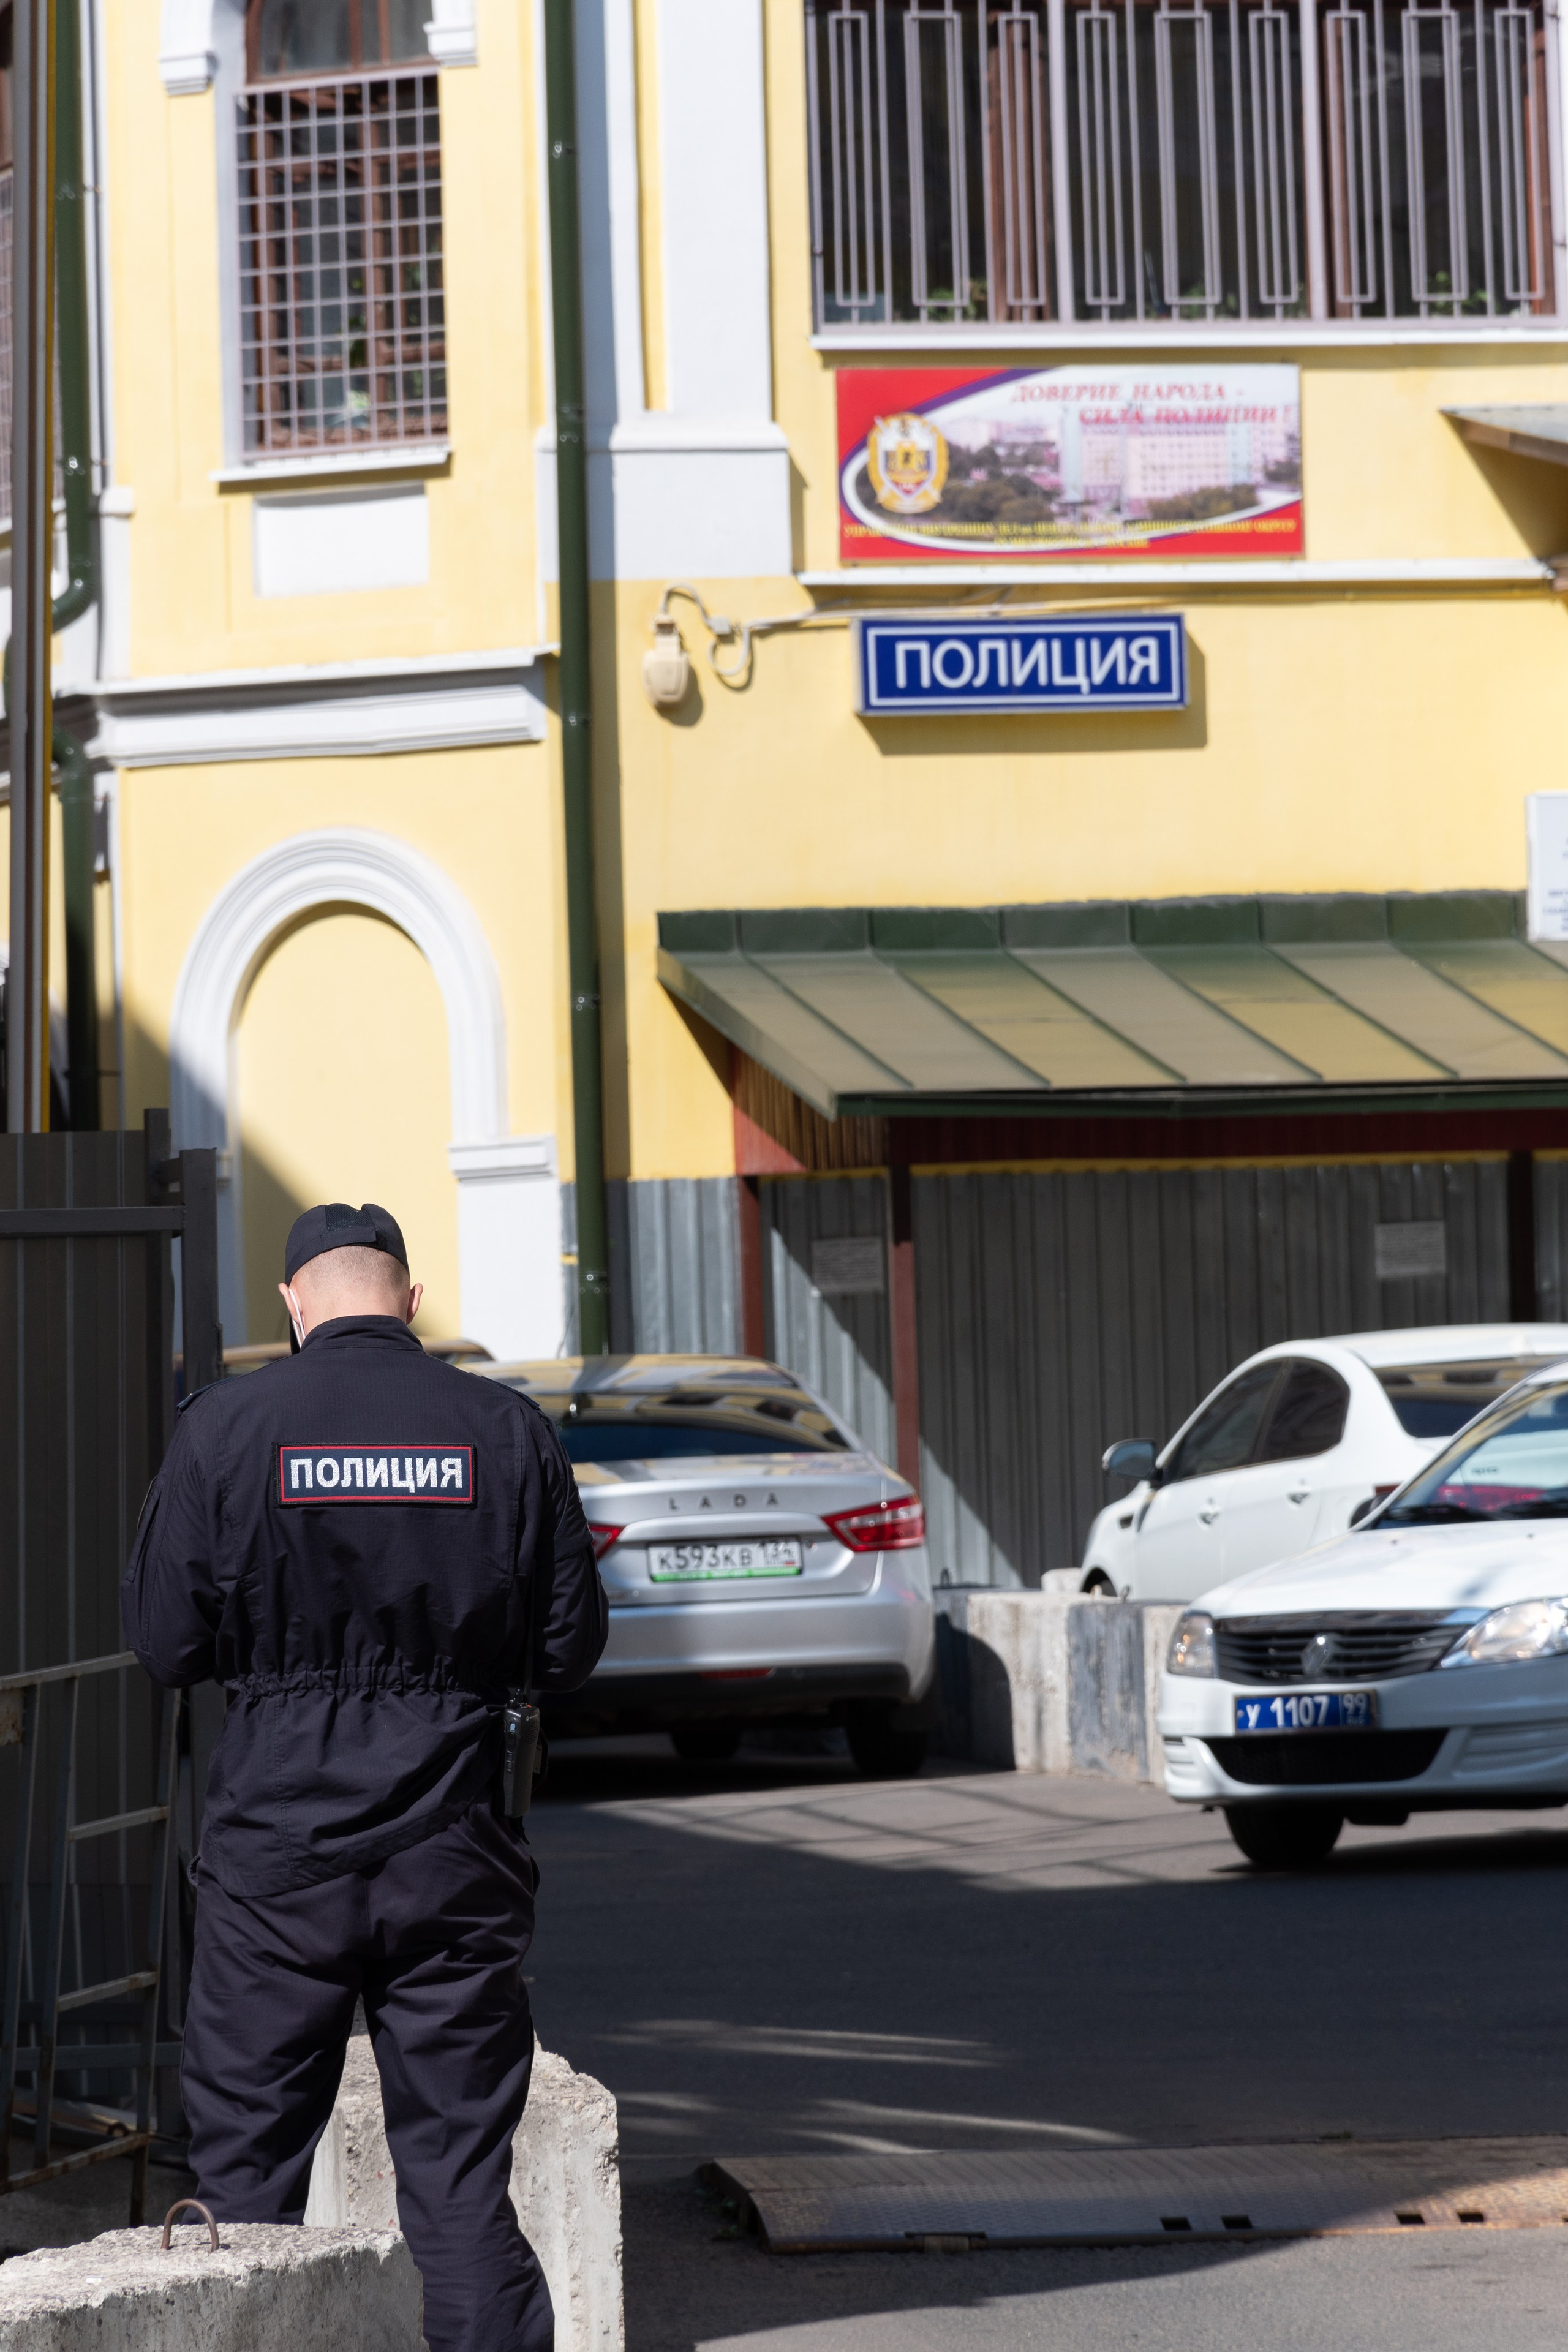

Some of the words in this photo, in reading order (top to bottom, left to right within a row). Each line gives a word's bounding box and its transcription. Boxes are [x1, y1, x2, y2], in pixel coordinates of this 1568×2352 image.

[1011, 383, 1120, 404] ДОВЕРИЕ
[1132, 383, 1225, 401] НАРОДА
[1079, 407, 1142, 424] СИЛА
[895, 636, 1159, 695] ПОЛИЦИЯ
[290, 1458, 462, 1493] ПОЛИЦИЯ
[668, 1493, 778, 1510] LADA
[1270, 1695, 1330, 1728] 1107
[1343, 1694, 1368, 1716] 99
